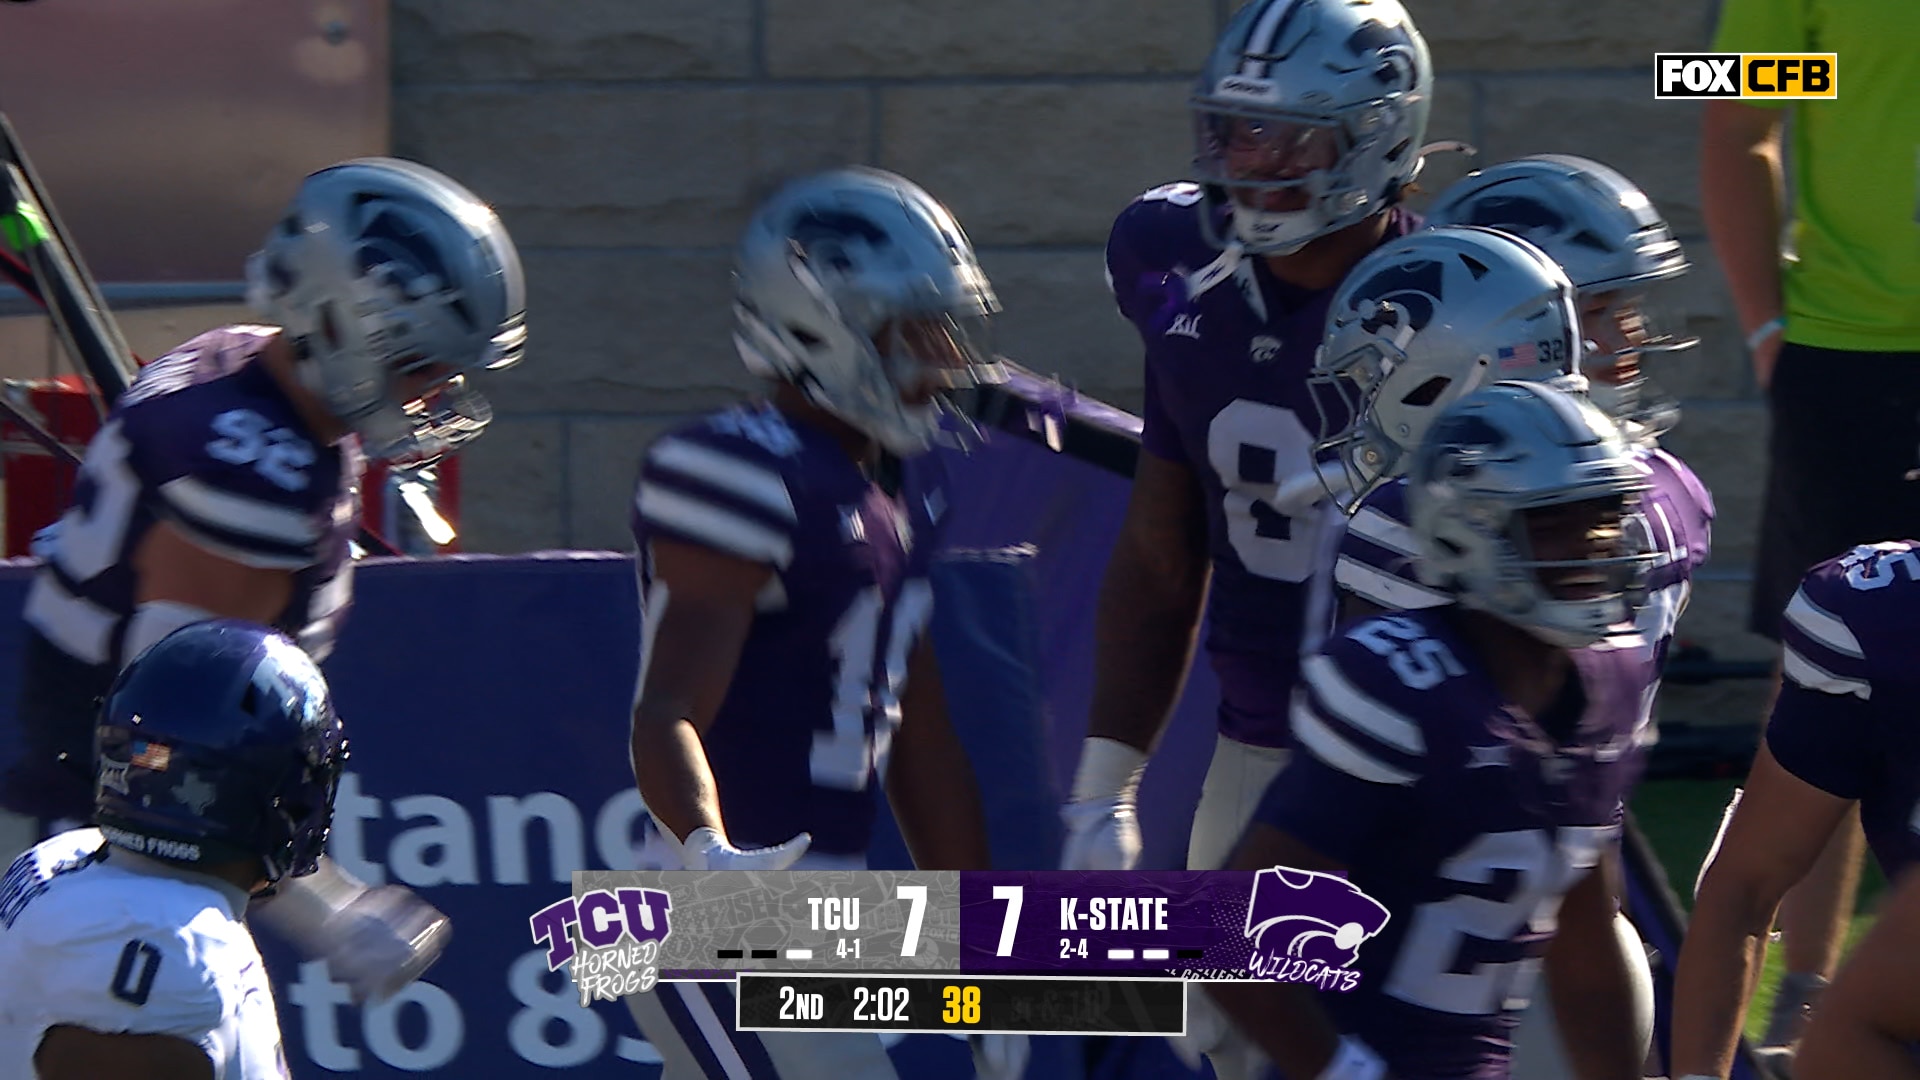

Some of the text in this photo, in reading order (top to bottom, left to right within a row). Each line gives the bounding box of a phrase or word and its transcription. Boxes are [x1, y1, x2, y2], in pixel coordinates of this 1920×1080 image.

[1538, 339, 1563, 363] 32
[1207, 398, 1331, 583] 8
[1344, 615, 1467, 690] 25
[111, 937, 162, 1007] 0
[290, 960, 465, 1073] to
